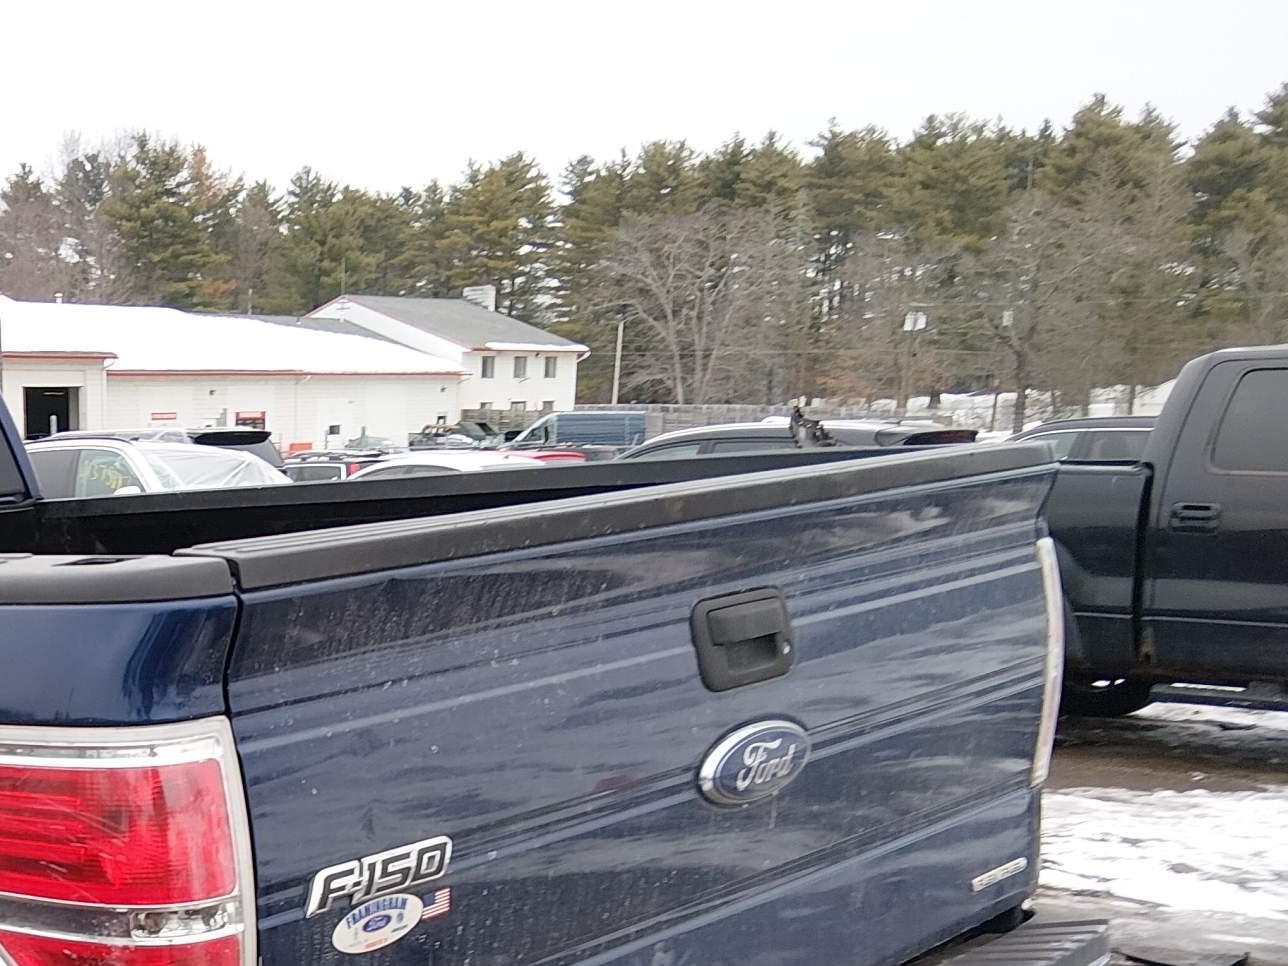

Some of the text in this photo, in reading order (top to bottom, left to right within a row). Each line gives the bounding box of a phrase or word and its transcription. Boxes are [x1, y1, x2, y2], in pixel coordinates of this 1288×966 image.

[735, 738, 797, 791] Ford
[309, 837, 452, 917] F-150
[345, 896, 409, 930] FRAMINGHAM
